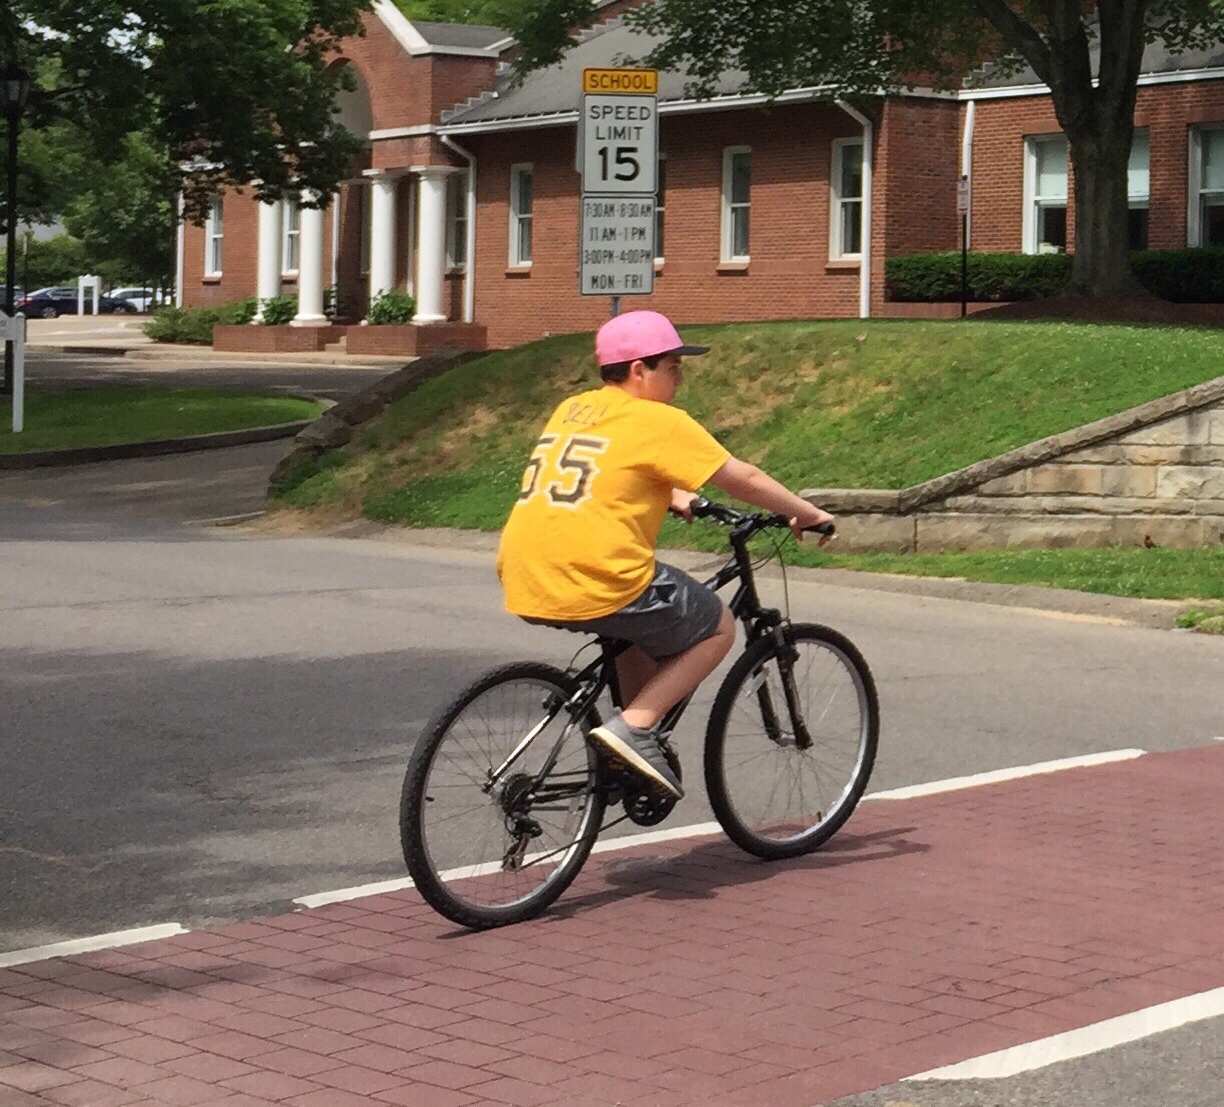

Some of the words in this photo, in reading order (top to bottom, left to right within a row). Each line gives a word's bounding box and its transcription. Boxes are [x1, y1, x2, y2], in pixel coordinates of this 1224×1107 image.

[589, 73, 652, 90] SCHOOL
[589, 105, 651, 121] SPEED
[595, 125, 643, 141] LIMIT
[598, 146, 640, 182] 15
[602, 227, 617, 241] AM
[631, 227, 646, 241] PM
[591, 274, 615, 289] MON
[624, 274, 643, 288] FRI
